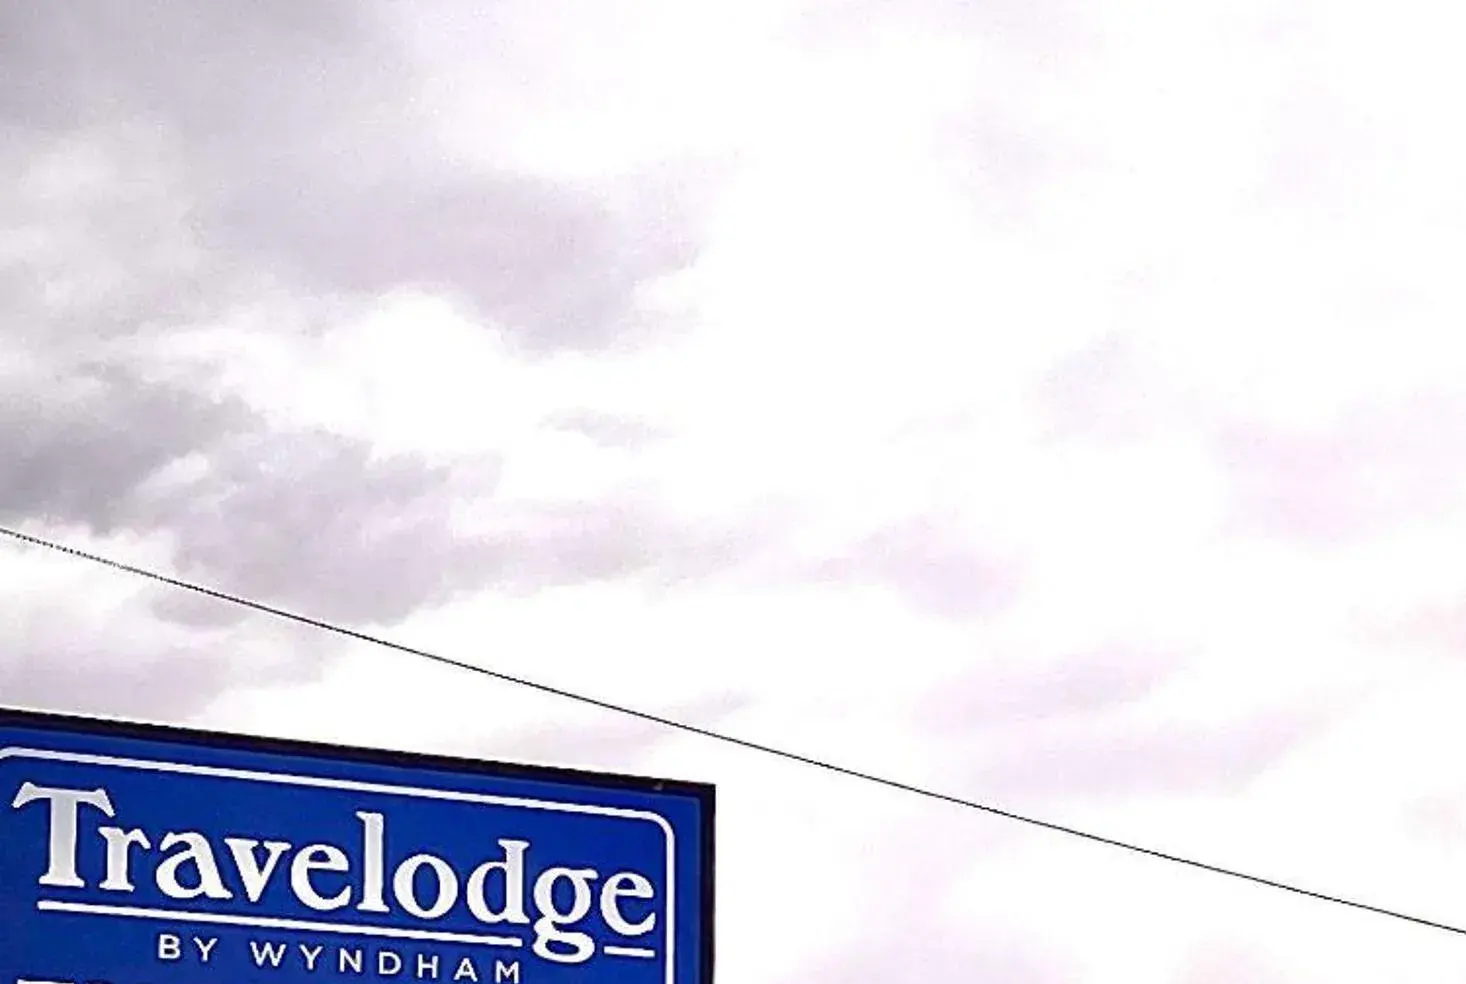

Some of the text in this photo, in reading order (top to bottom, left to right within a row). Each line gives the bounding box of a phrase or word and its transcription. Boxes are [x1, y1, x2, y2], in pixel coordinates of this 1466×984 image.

[12, 781, 656, 963] Travelodge
[158, 934, 521, 984] BY WYNDHAM
